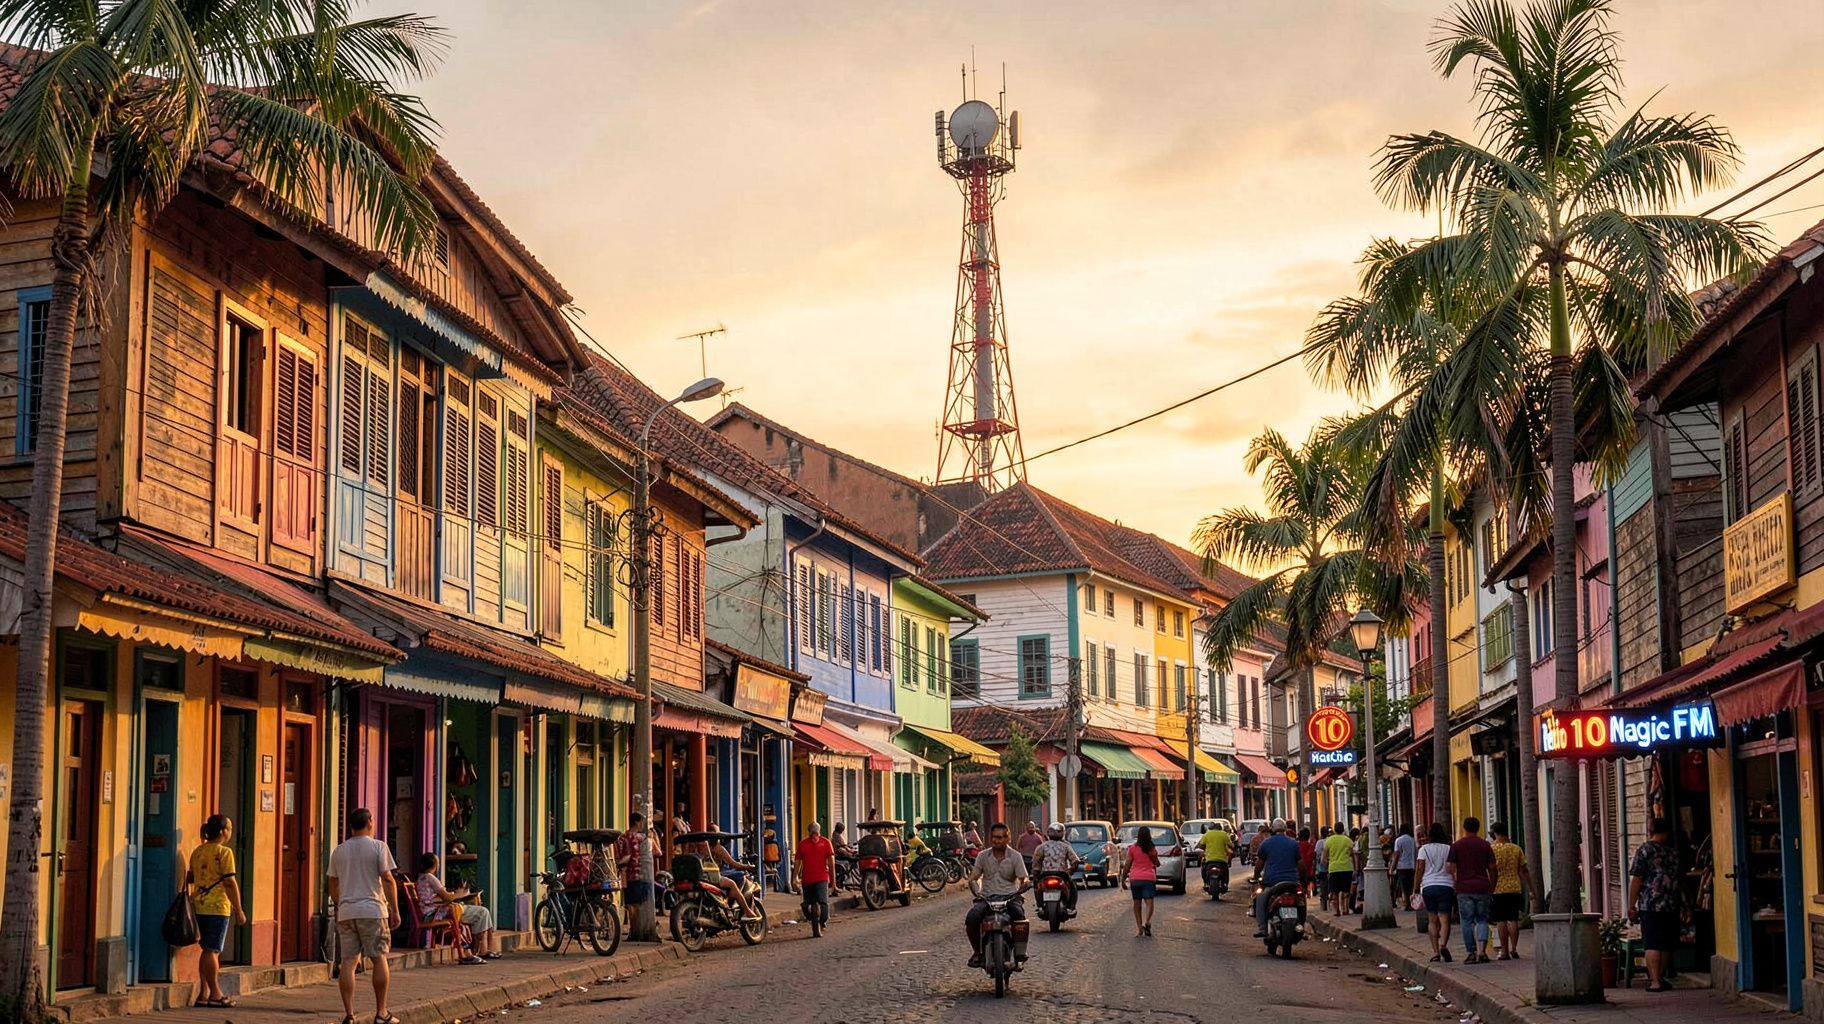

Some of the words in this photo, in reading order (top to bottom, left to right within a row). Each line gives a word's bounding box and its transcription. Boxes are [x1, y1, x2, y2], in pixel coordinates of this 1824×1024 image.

[1315, 718, 1345, 744] 10
[1570, 717, 1606, 747] 10
[1673, 706, 1715, 740] FM
